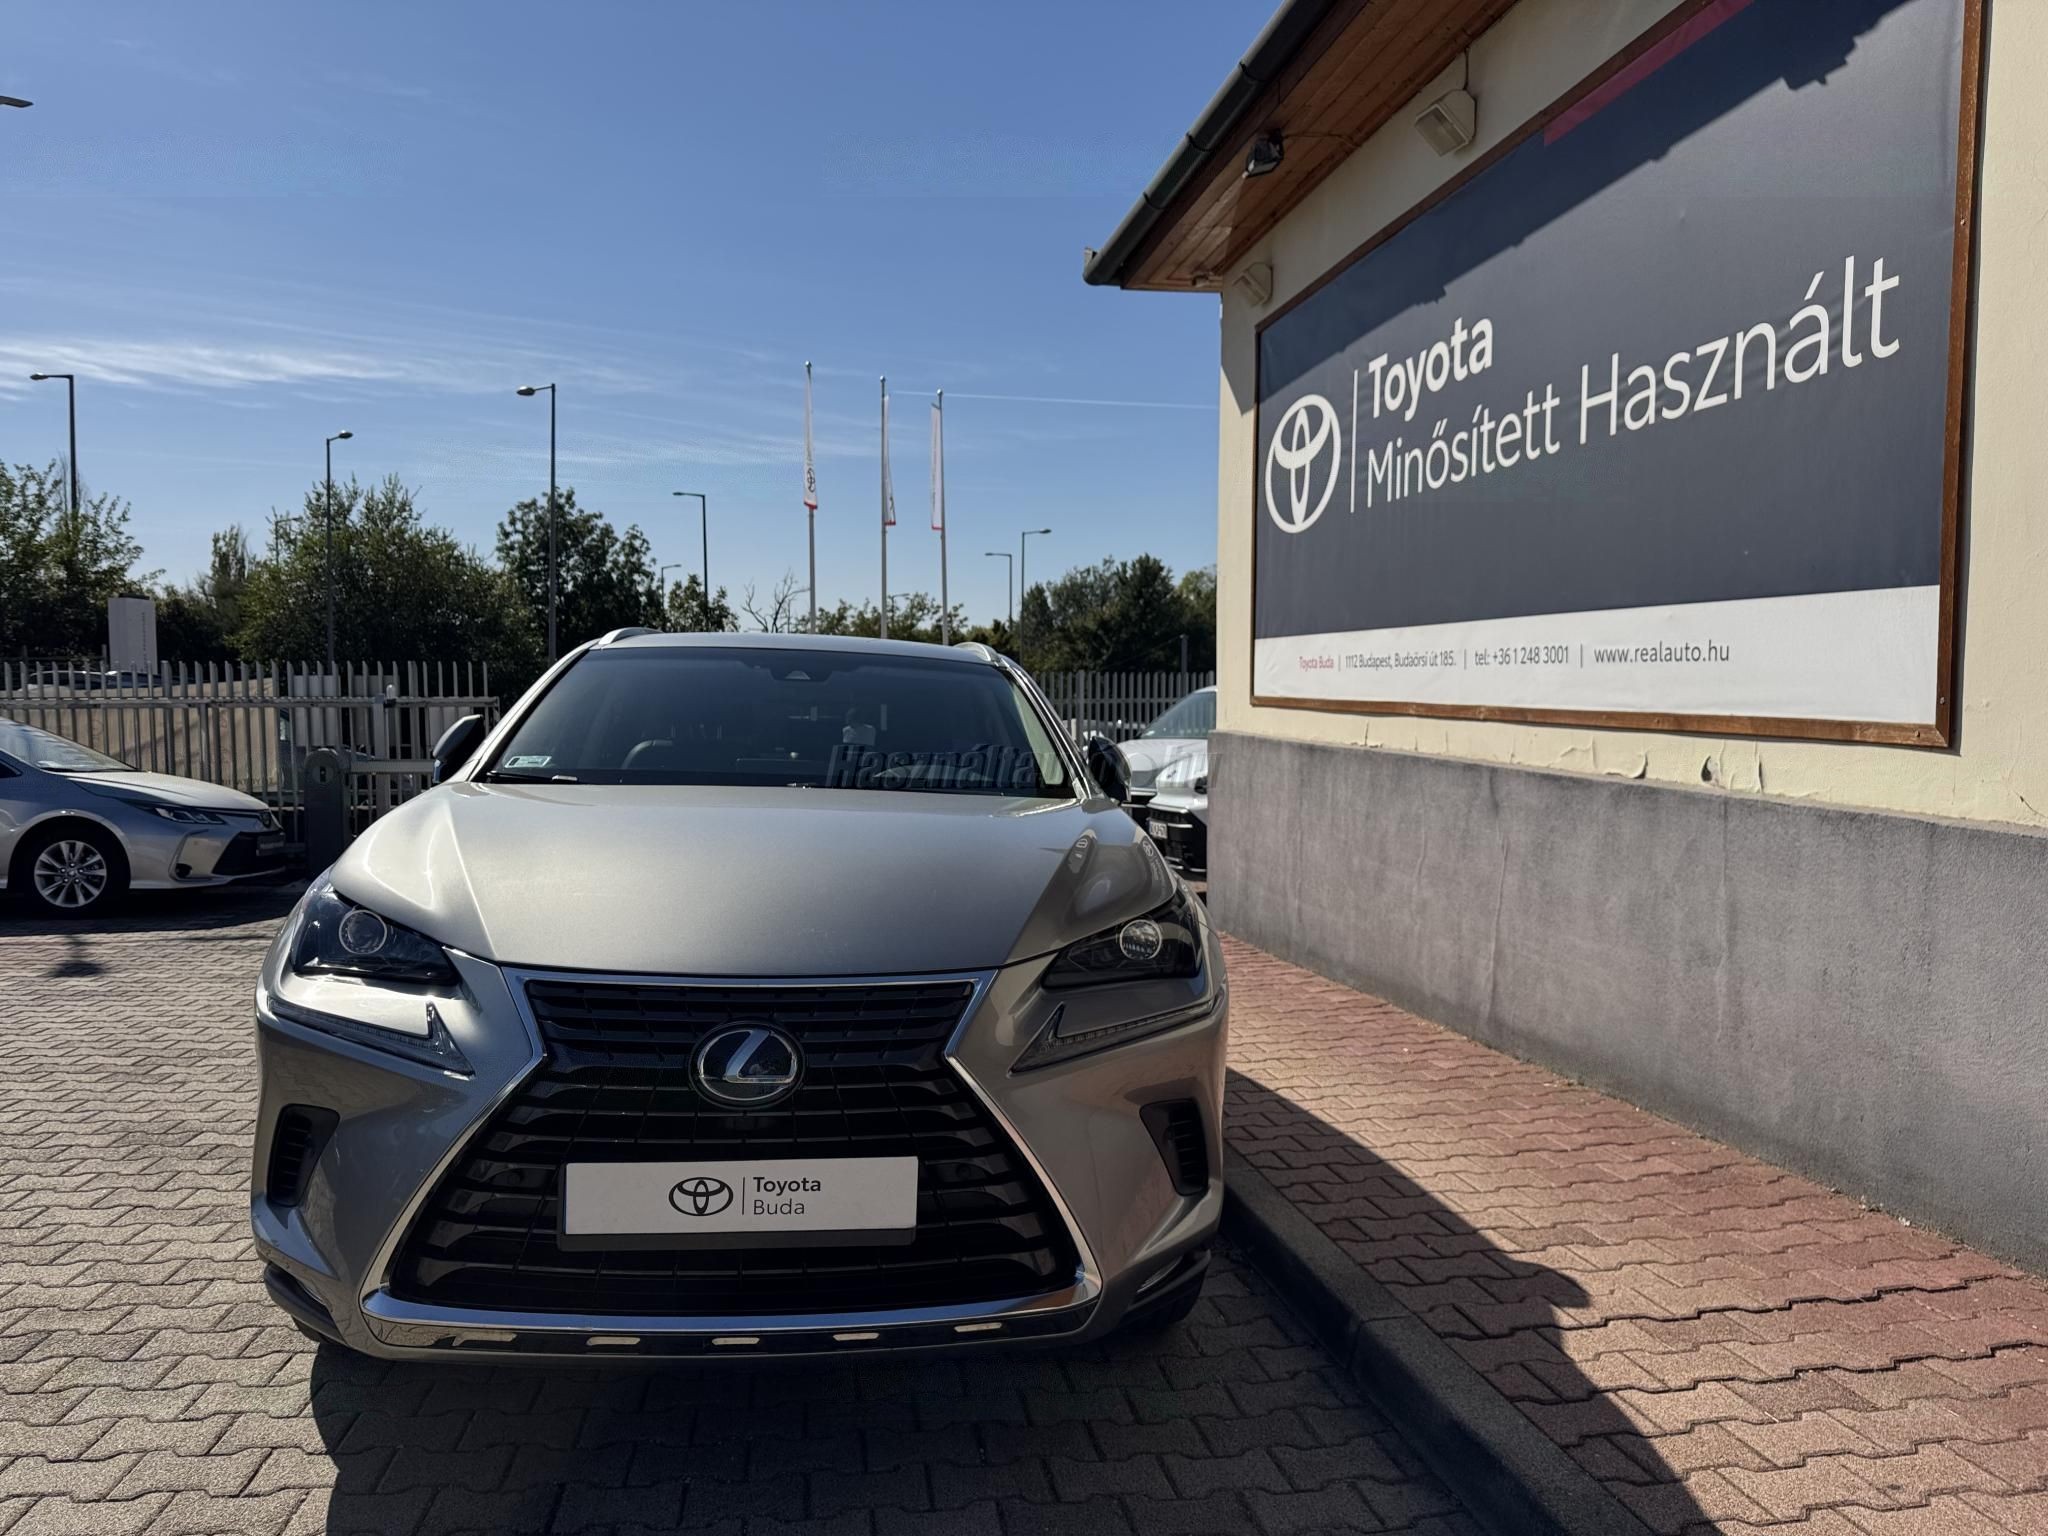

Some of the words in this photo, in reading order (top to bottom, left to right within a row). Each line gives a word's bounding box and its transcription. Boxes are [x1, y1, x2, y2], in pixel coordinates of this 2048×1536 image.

[1367, 383, 1561, 508] Minősített
[1579, 255, 1900, 445] Használt
[1368, 317, 1494, 422] Toyota
[1299, 656, 1318, 672] Toyota
[1319, 655, 1334, 669] Buda
[1345, 653, 1358, 669] 1112
[1359, 651, 1393, 671] Budapest,
[1394, 649, 1428, 668] Budaörsi
[1429, 650, 1439, 667] út
[1440, 649, 1457, 667] 185.
[1474, 648, 1491, 666] tel:
[1492, 646, 1511, 665] +36
[1519, 646, 1541, 665] 248
[1542, 645, 1570, 664] 3001
[1594, 639, 1730, 664] www.realauto.hu
[752, 1175, 822, 1195] Toyota
[752, 1199, 806, 1216] Buda
